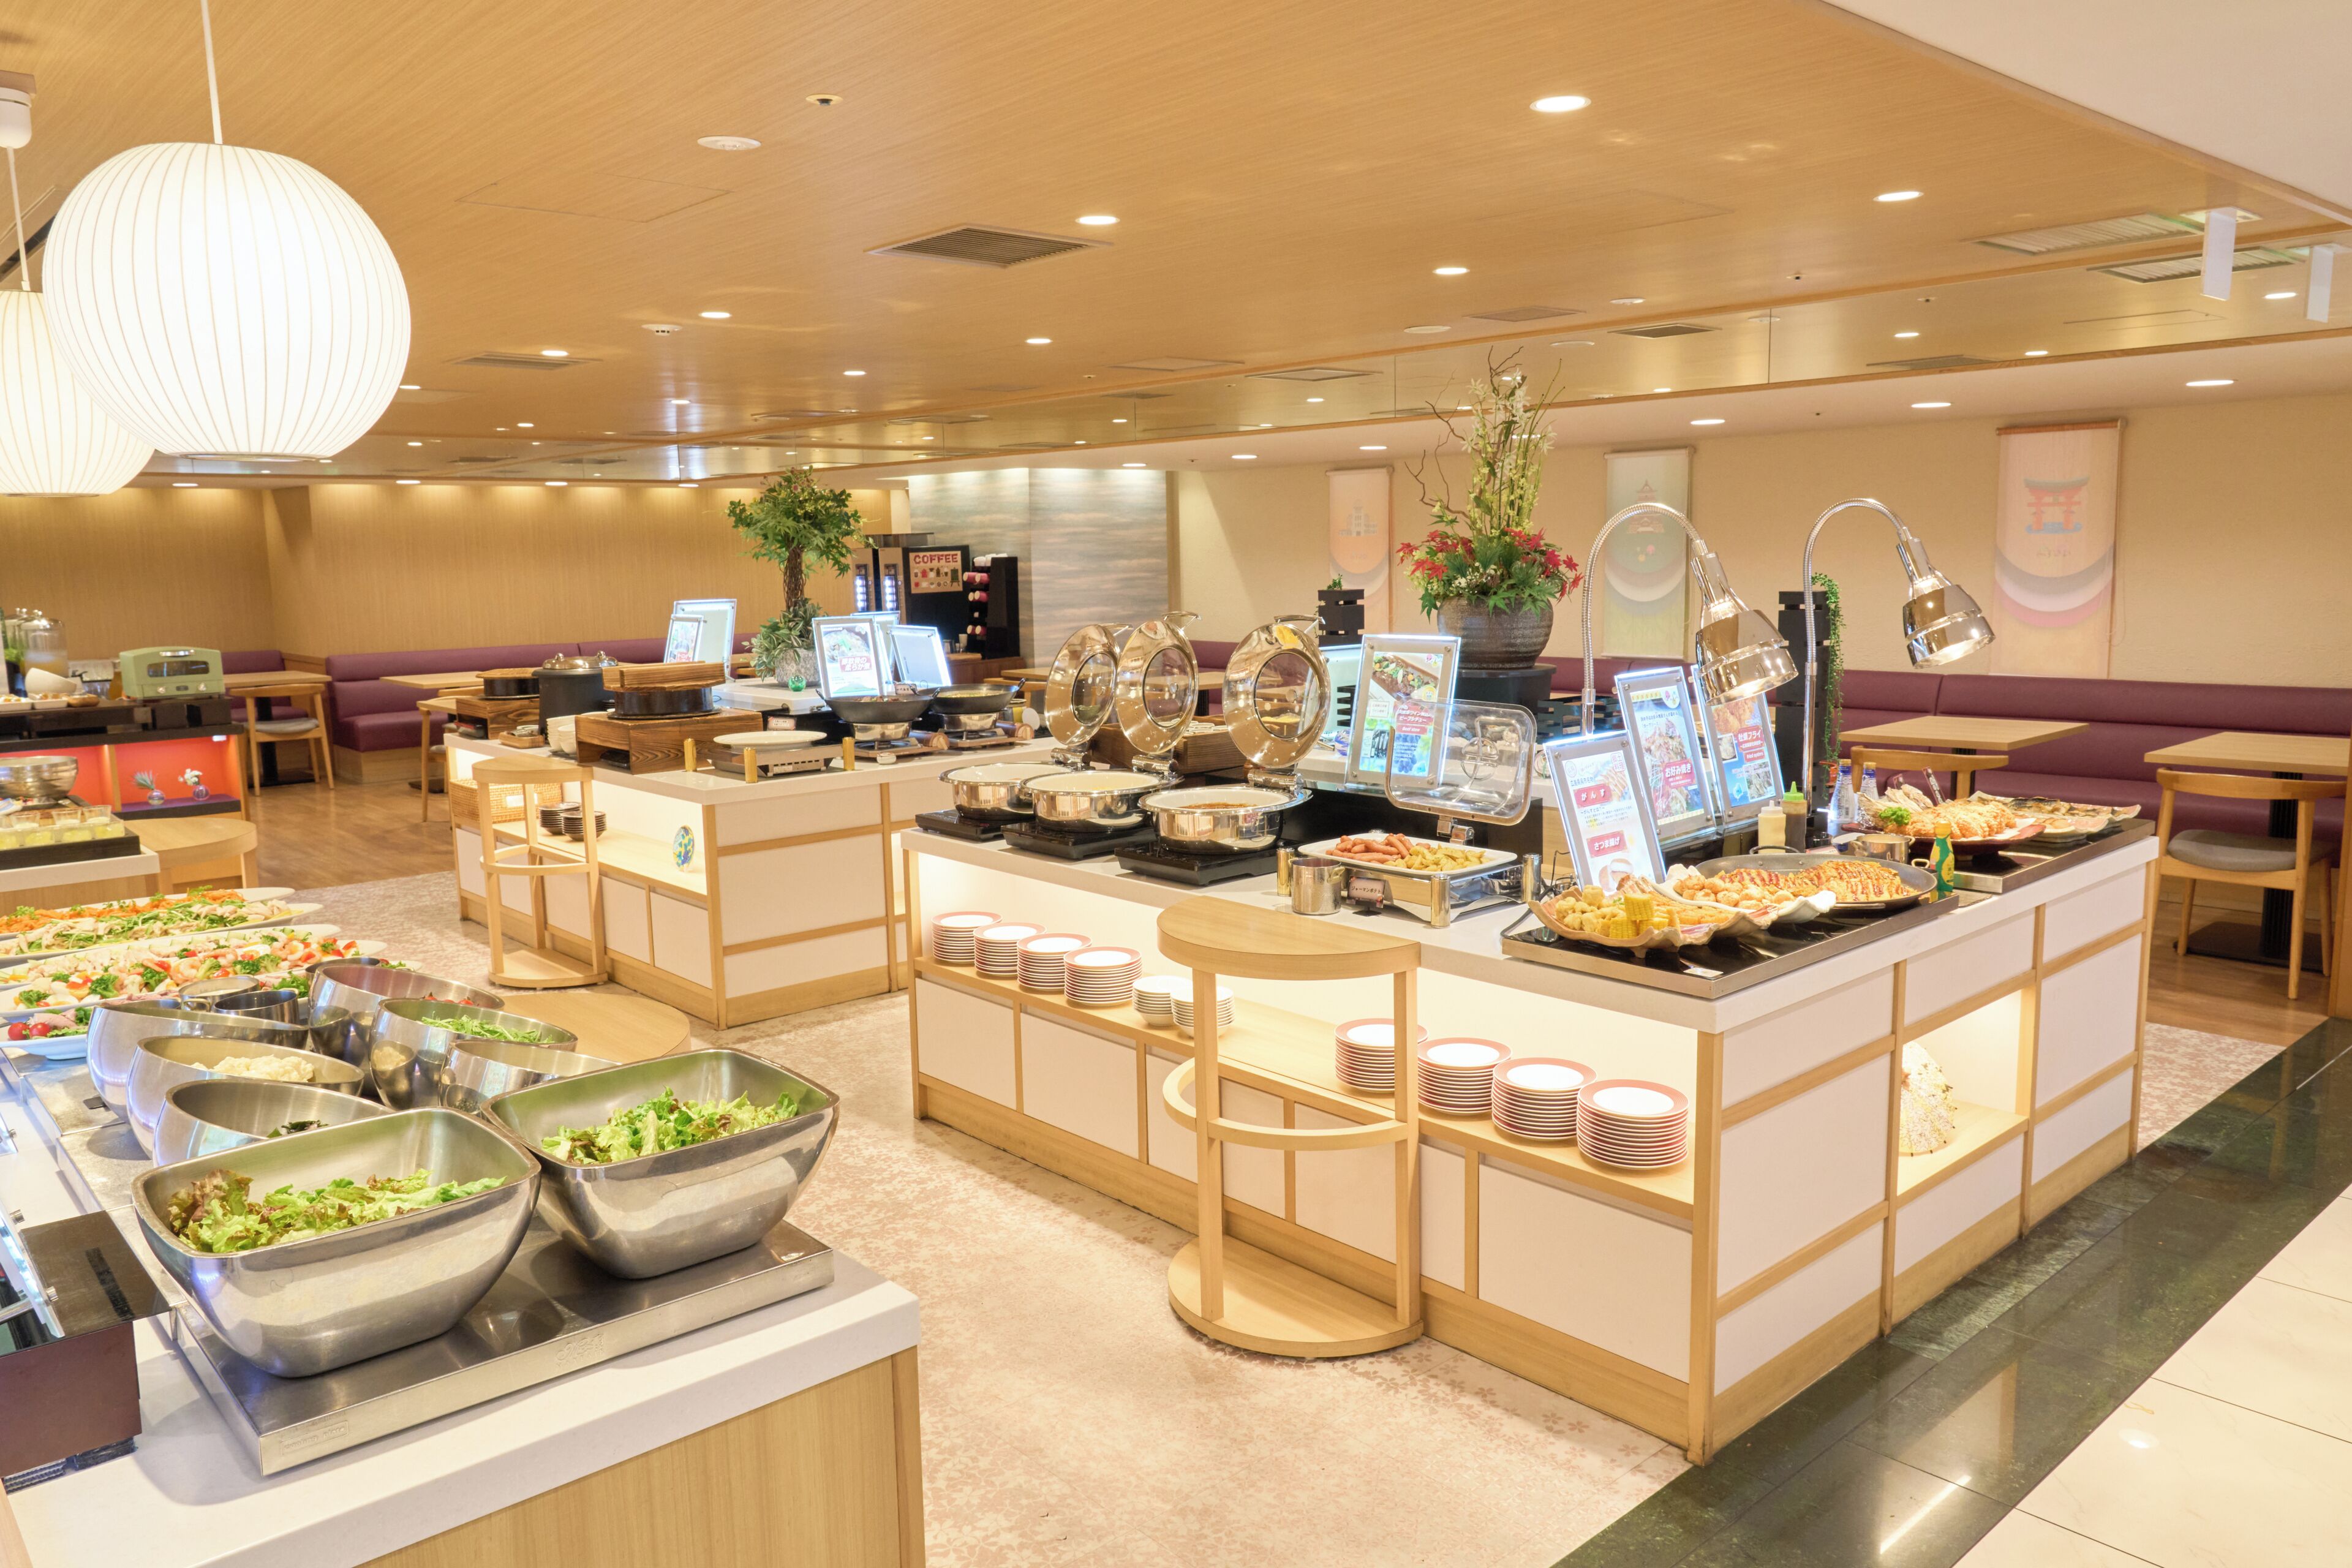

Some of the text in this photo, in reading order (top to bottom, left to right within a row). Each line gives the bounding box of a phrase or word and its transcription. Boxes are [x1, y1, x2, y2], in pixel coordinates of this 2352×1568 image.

[913, 553, 958, 564] COFFEE
[1738, 729, 1761, 742] 牡蠣フライ
[1665, 763, 1691, 777] お好み焼き
[1581, 788, 1606, 801] がんす
[1594, 837, 1621, 851] さつま揚げ
[323, 1427, 345, 1440] plate
